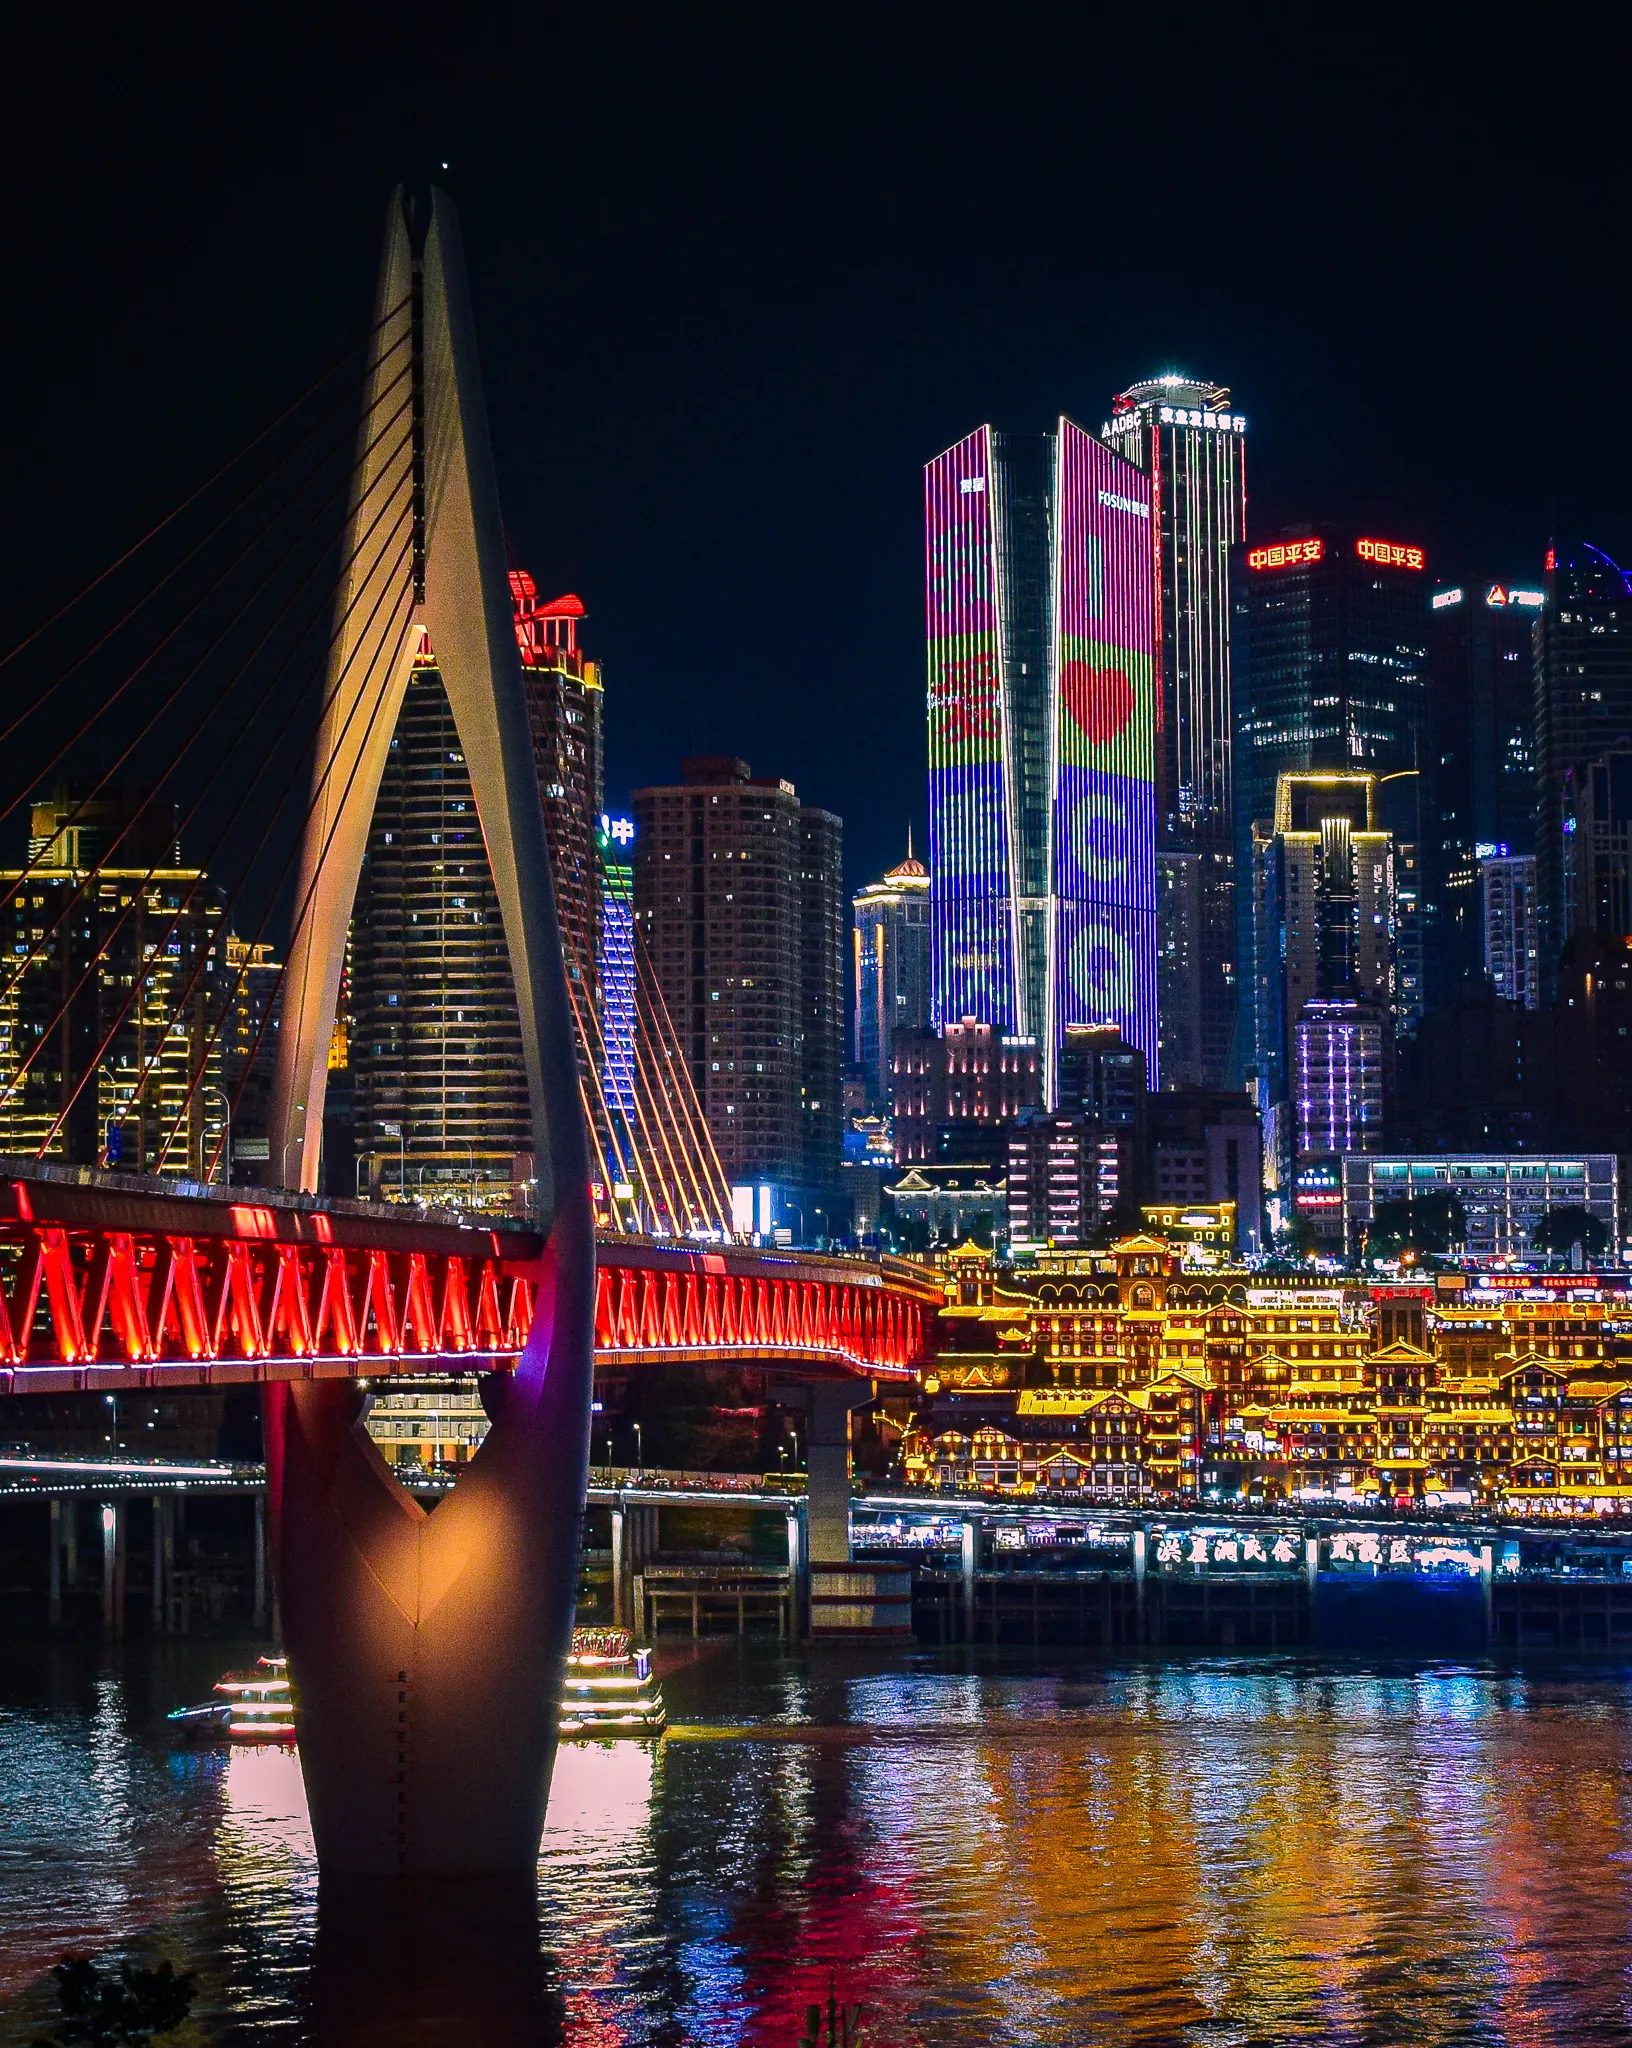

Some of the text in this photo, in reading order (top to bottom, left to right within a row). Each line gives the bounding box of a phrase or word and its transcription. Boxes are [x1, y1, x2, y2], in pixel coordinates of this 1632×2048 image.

[1097, 490, 1131, 513] FOSUN
[1249, 540, 1321, 570] 中国平安
[1357, 539, 1423, 570] 中国平安
